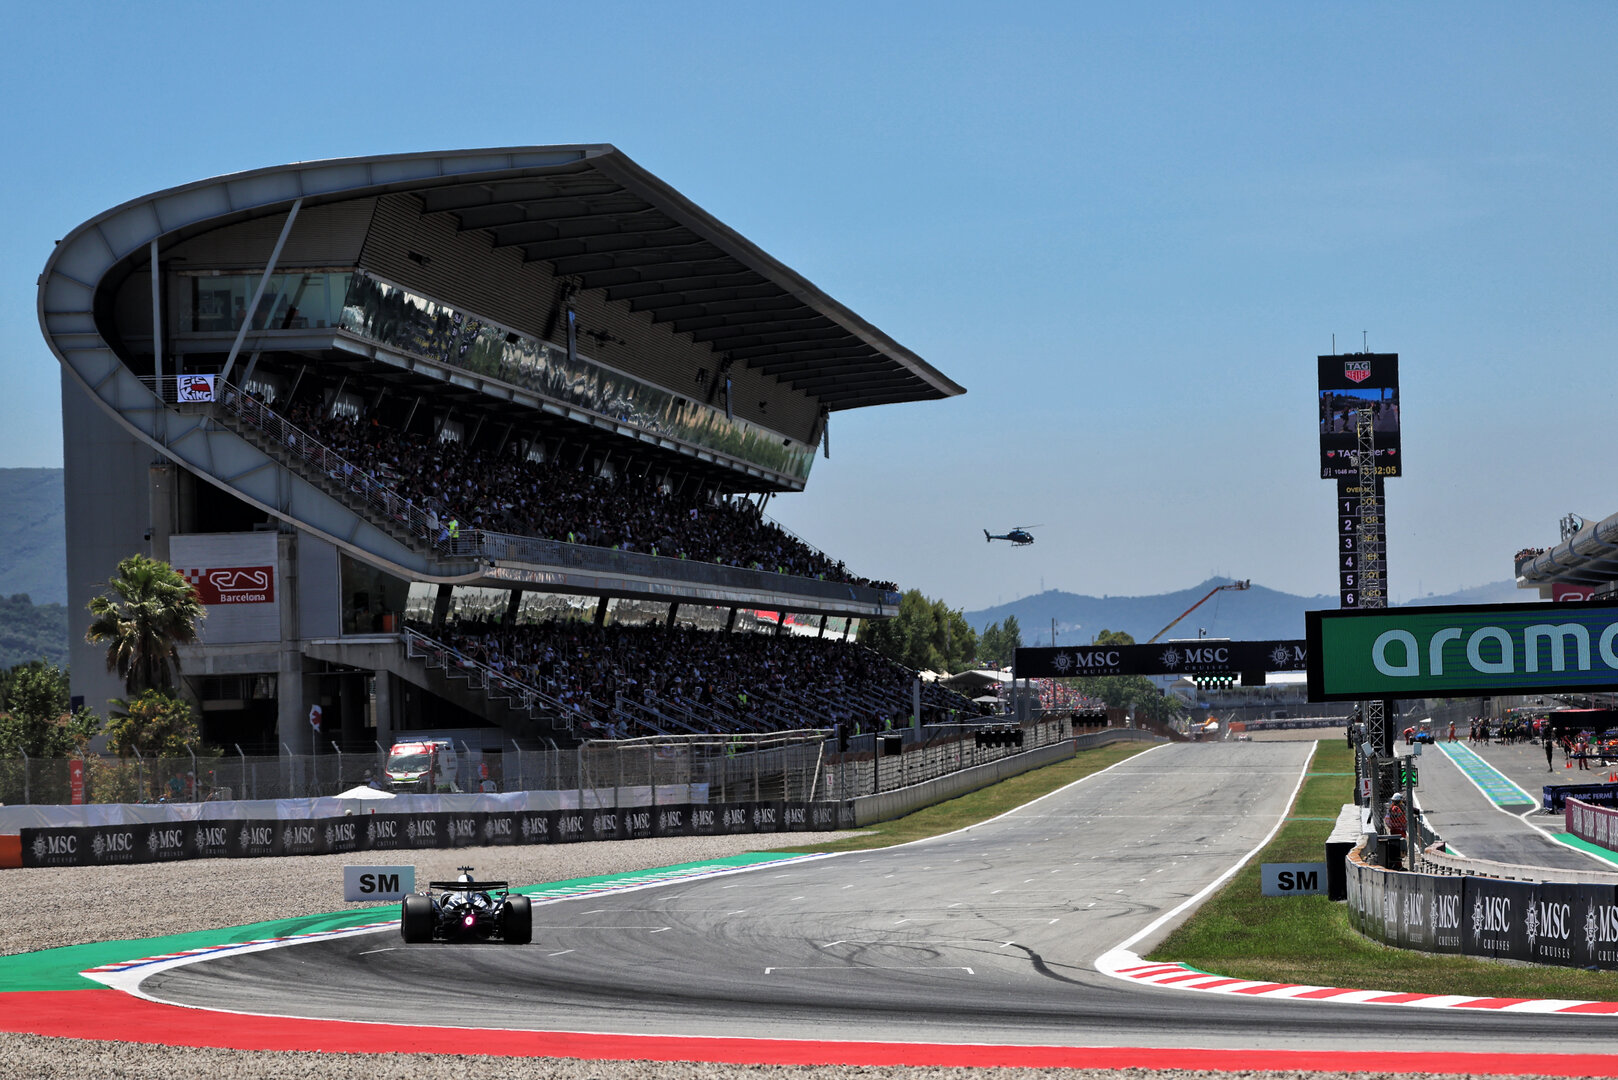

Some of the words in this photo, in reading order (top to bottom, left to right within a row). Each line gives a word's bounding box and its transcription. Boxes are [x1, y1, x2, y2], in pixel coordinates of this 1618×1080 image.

[1347, 362, 1368, 370] TAG
[1344, 501, 1350, 512] 1
[1344, 520, 1352, 531] 2
[1345, 538, 1352, 549] 3
[1345, 556, 1353, 567] 4
[1346, 574, 1354, 586] 5
[220, 593, 266, 602] Barcelona
[1346, 592, 1354, 604] 6
[1076, 651, 1120, 668] MSC
[1185, 648, 1229, 664] MSC
[205, 827, 227, 846] MSC
[251, 828, 272, 845] MSC
[294, 827, 315, 844] MSC
[335, 824, 356, 842] MSC
[376, 820, 397, 838] MSC
[417, 820, 436, 836] MSC
[48, 835, 77, 854] MSC
[106, 833, 133, 852] MSC
[159, 830, 182, 848] MSC
[359, 873, 399, 893] SM
[1277, 871, 1318, 891] SM
[1439, 895, 1459, 929] MSC
[1484, 897, 1511, 933] MSC
[1540, 901, 1570, 940] MSC
[1483, 938, 1510, 952] CRUISES
[1540, 945, 1570, 959] CRUISES
